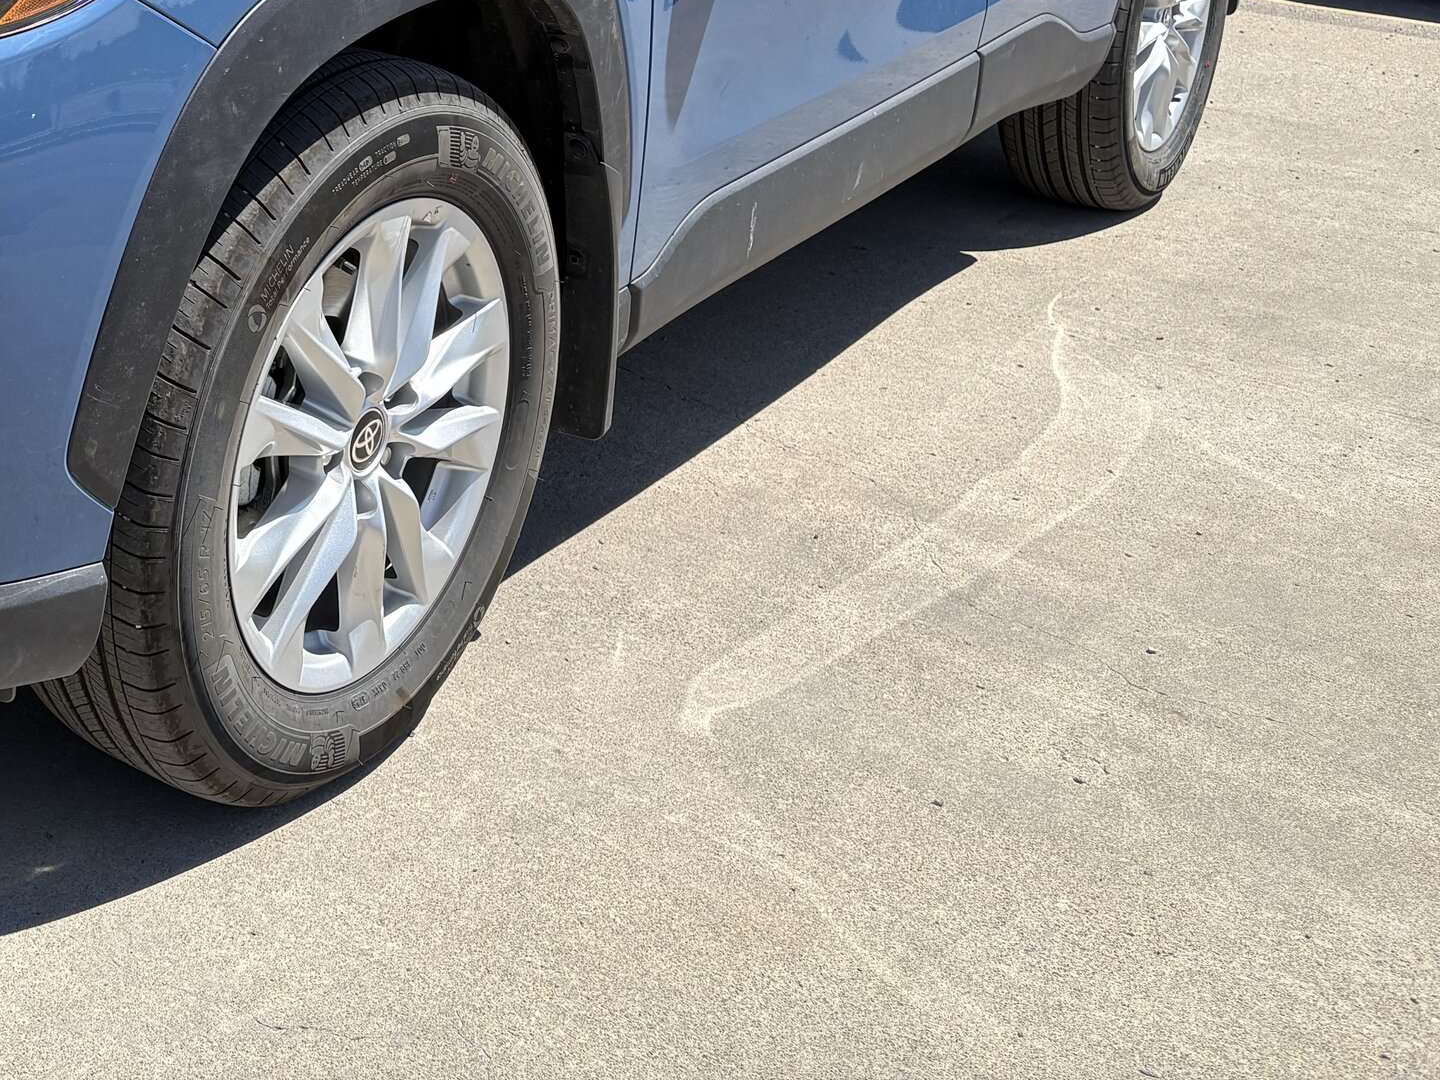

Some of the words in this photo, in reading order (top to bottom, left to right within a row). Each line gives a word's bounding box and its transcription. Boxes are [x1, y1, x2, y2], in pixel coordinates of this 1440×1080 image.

[481, 146, 553, 268] MICHELIN
[260, 244, 295, 303] MICHELIN
[211, 665, 308, 767] MICHELIN
